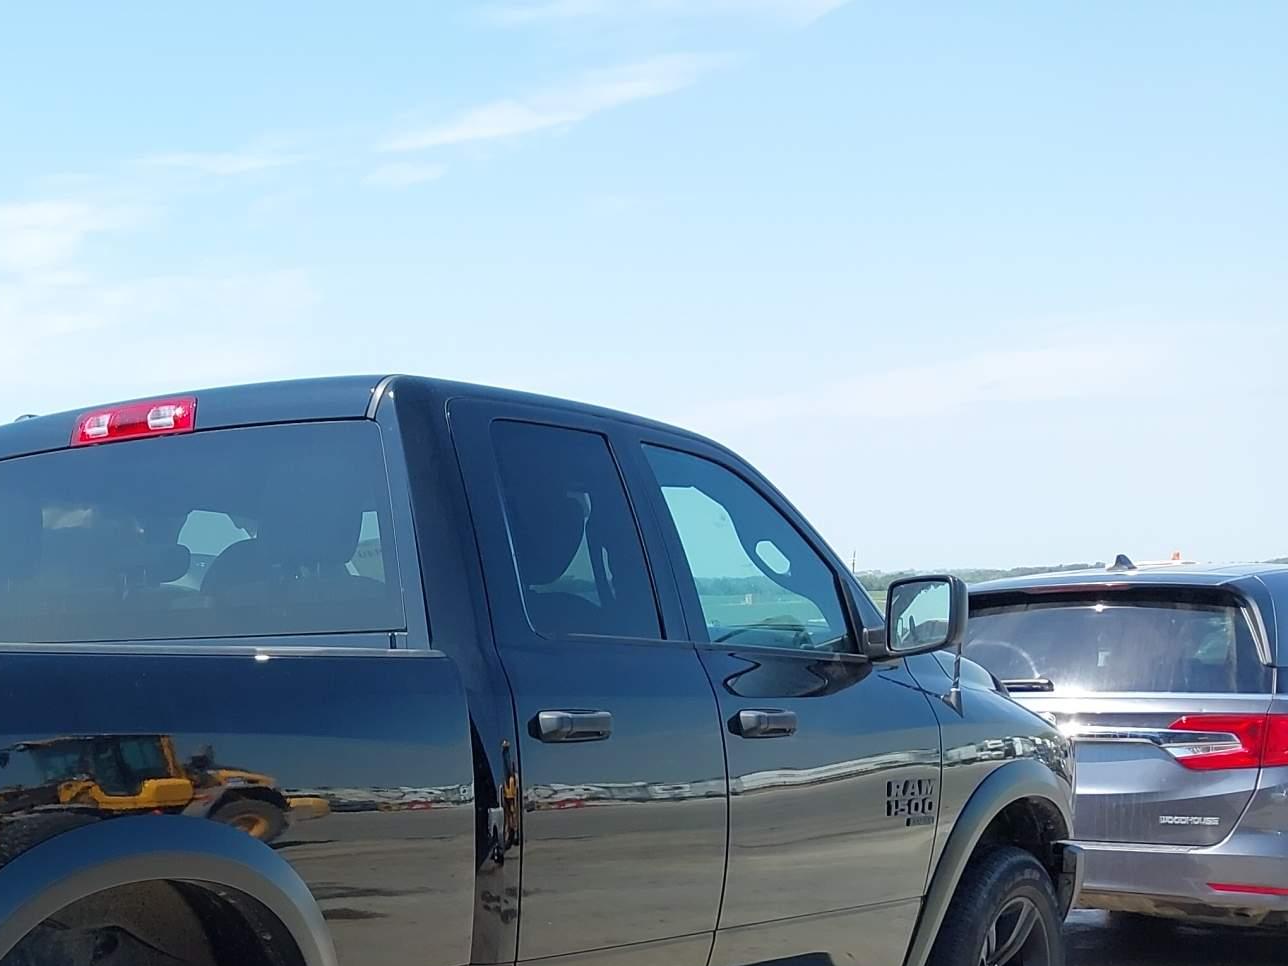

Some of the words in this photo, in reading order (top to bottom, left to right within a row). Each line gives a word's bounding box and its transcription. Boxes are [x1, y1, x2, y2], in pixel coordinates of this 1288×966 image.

[886, 779, 935, 797] RAM
[886, 797, 935, 817] 1500
[1159, 815, 1220, 826] WOODHOUSE
